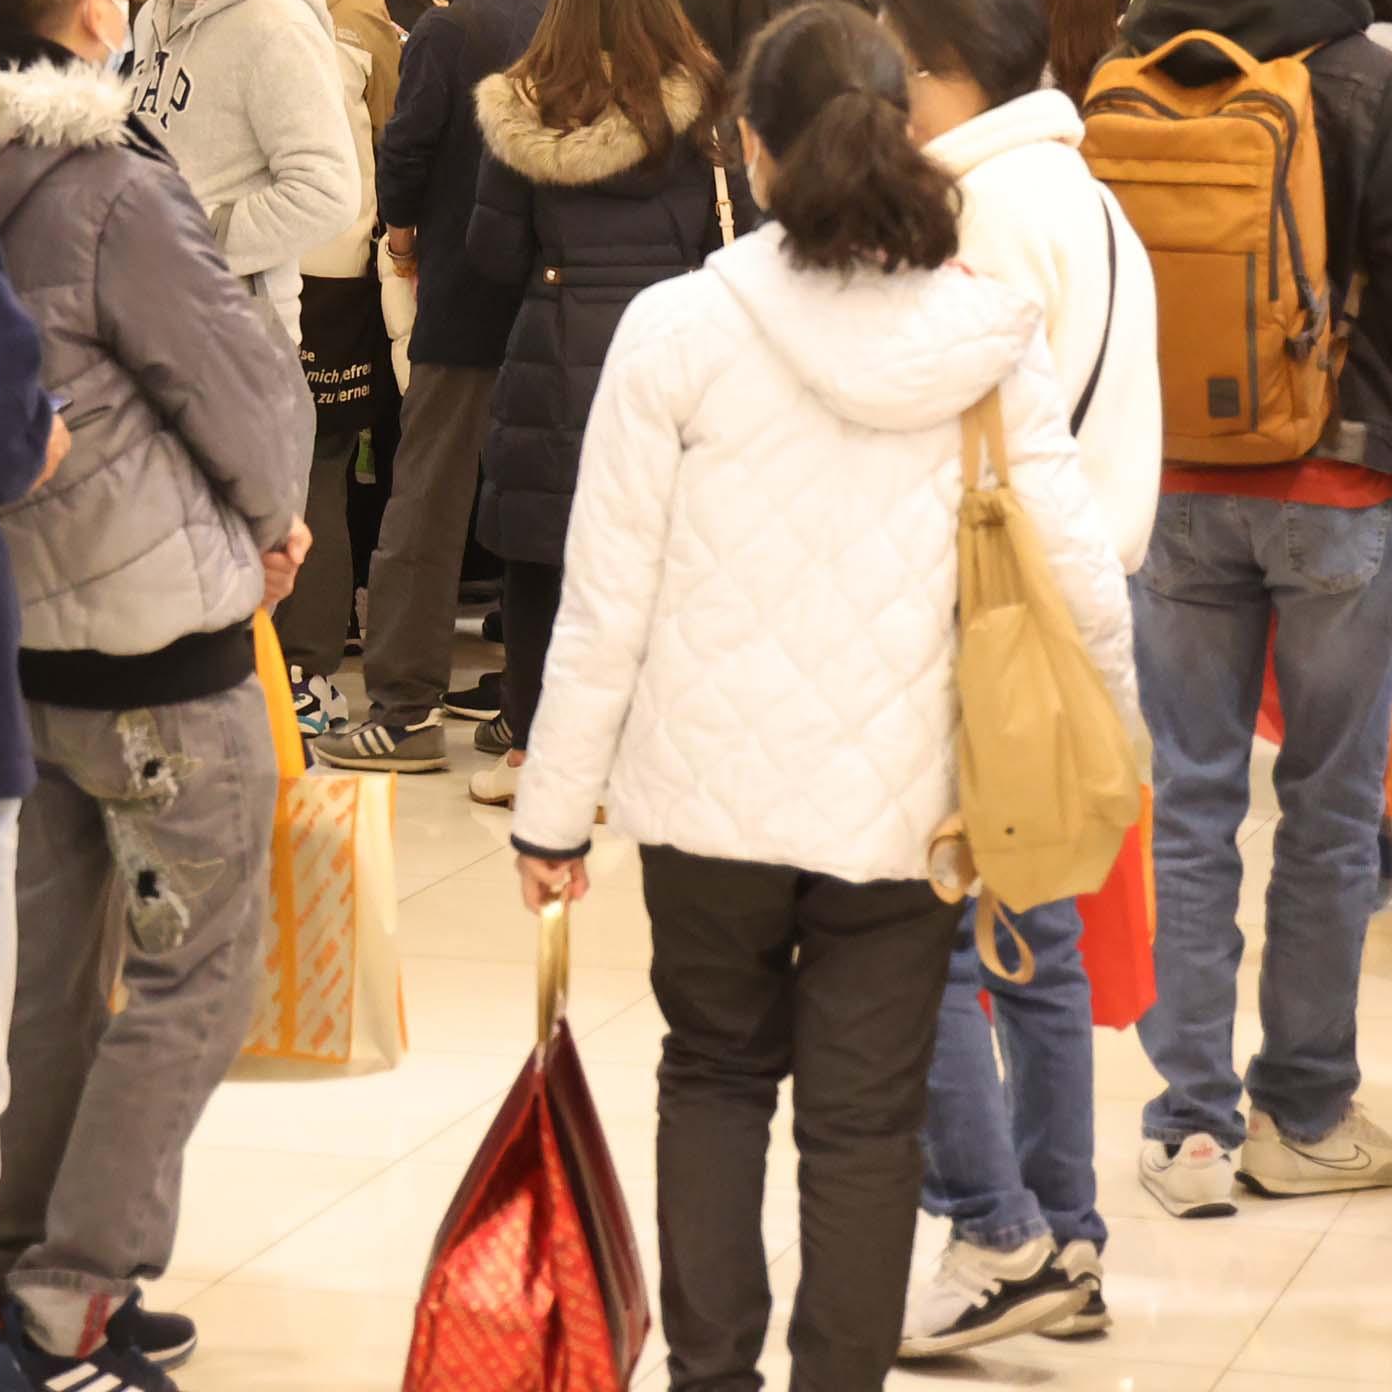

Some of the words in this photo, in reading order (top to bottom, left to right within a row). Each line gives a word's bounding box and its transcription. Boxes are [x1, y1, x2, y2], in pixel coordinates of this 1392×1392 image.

[306, 369, 339, 383] mich
[340, 363, 372, 384] efre
[317, 393, 336, 404] zu
